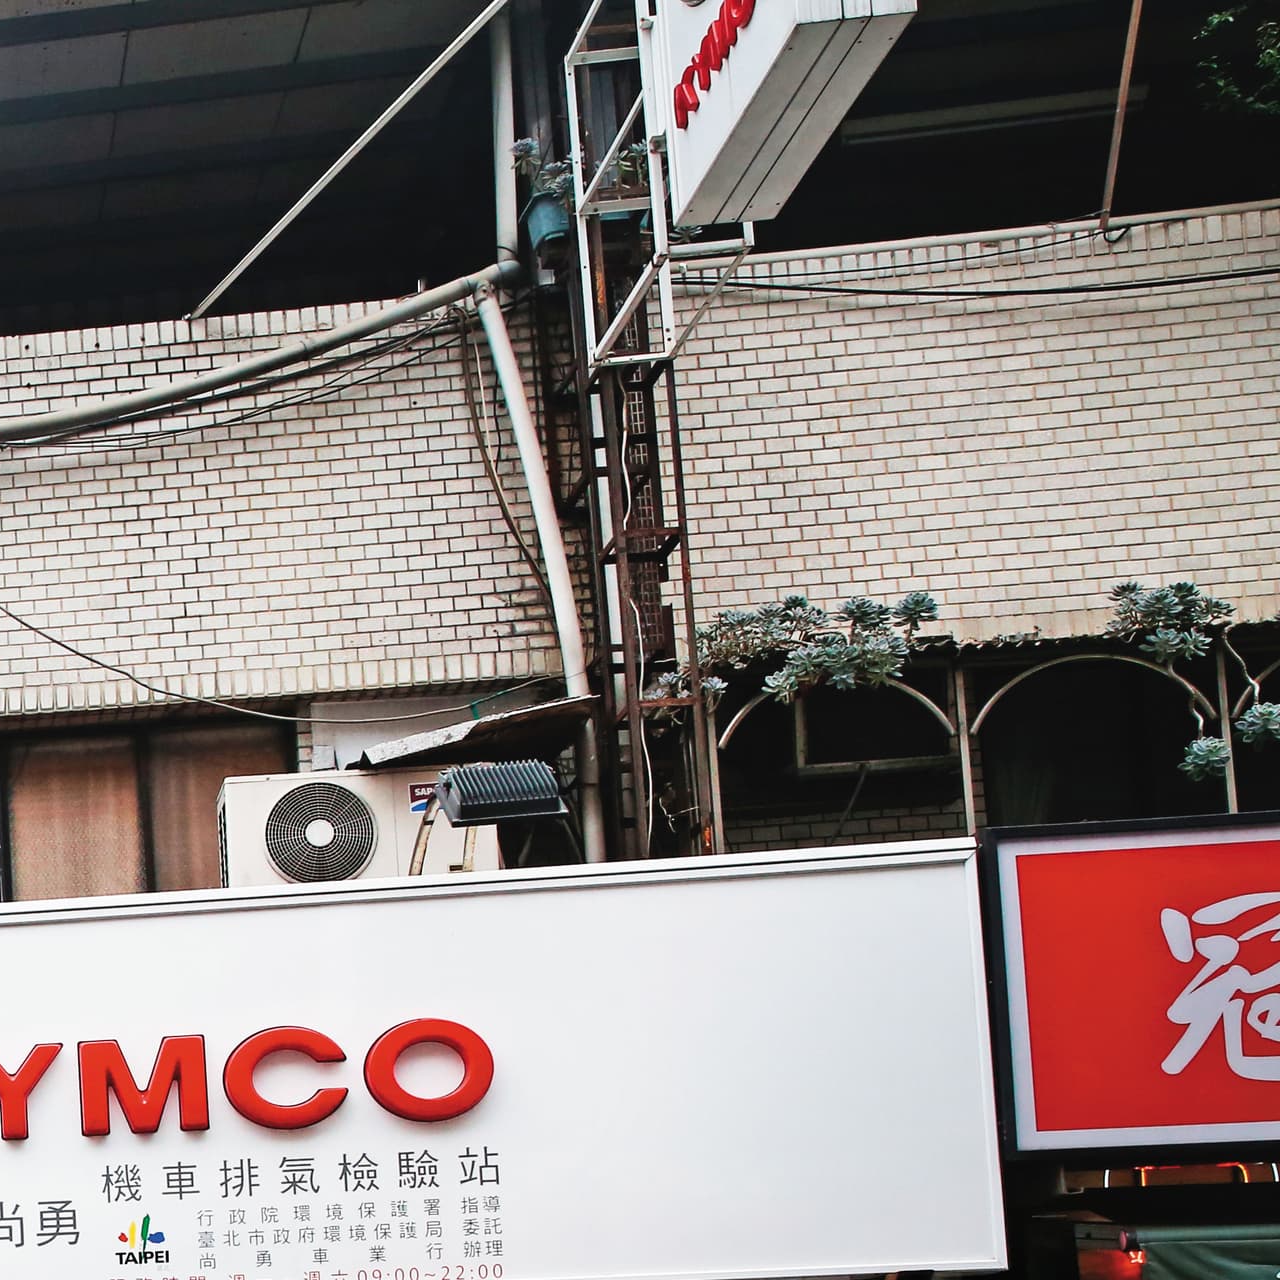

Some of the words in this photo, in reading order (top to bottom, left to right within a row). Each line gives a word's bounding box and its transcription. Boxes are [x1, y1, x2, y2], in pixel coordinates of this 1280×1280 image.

[101, 1146, 501, 1203] 機車排氣檢驗站
[197, 1197, 441, 1227] 行政院環境保護署
[461, 1196, 502, 1213] 指導
[197, 1220, 443, 1249] 臺北市政府環境保護局
[462, 1217, 503, 1236] 委託
[115, 1250, 170, 1266] TAIPEI
[199, 1243, 444, 1270] 尚勇車業行
[463, 1240, 504, 1259] 辦理
